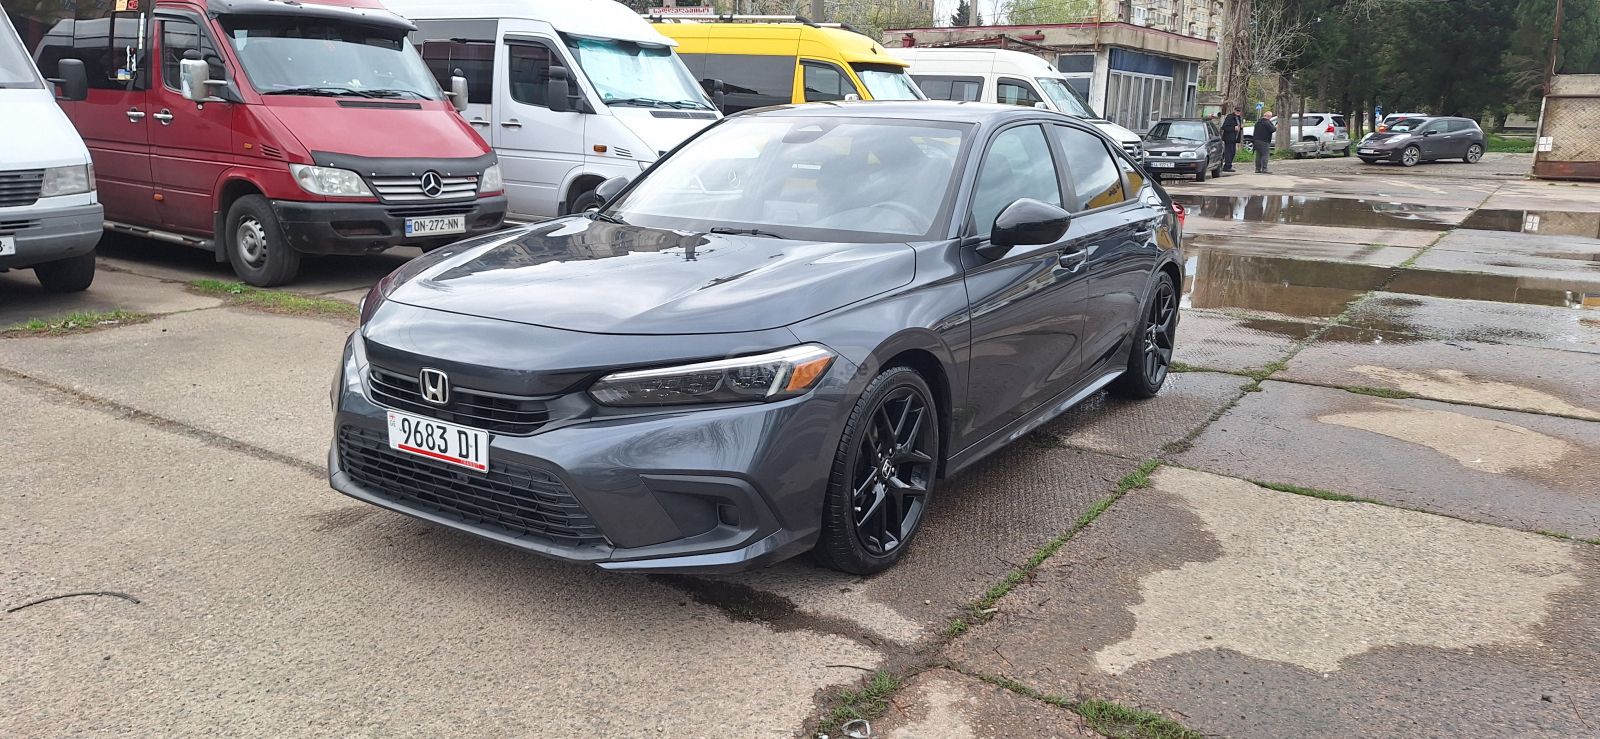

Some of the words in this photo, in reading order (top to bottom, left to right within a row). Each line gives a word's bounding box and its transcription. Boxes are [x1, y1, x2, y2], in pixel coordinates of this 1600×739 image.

[413, 218, 459, 232] ON-272-NN
[401, 417, 448, 454] 9683
[457, 429, 479, 462] DI
